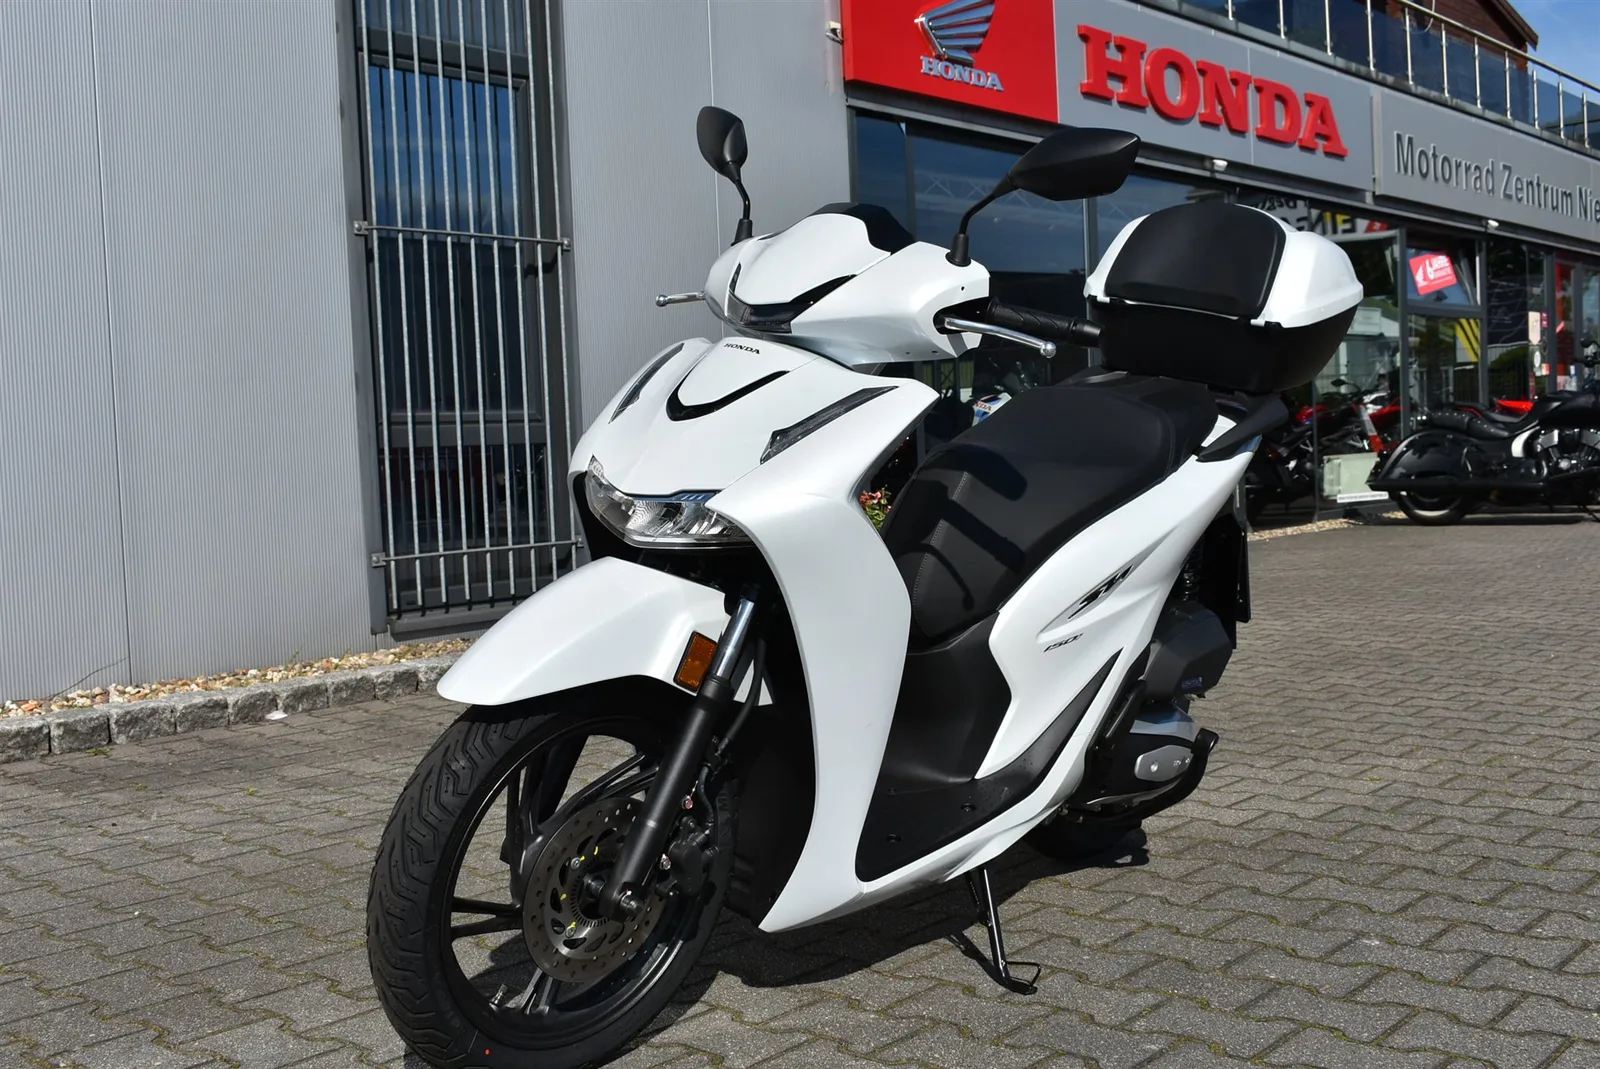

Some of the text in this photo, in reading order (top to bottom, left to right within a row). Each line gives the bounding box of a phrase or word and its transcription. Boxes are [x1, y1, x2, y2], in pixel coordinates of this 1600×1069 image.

[920, 55, 1004, 91] HONDA
[1077, 24, 1349, 158] HONDA
[1394, 130, 1495, 197] Motorrad
[1500, 162, 1573, 217] Zentrum
[723, 342, 760, 355] HONDA
